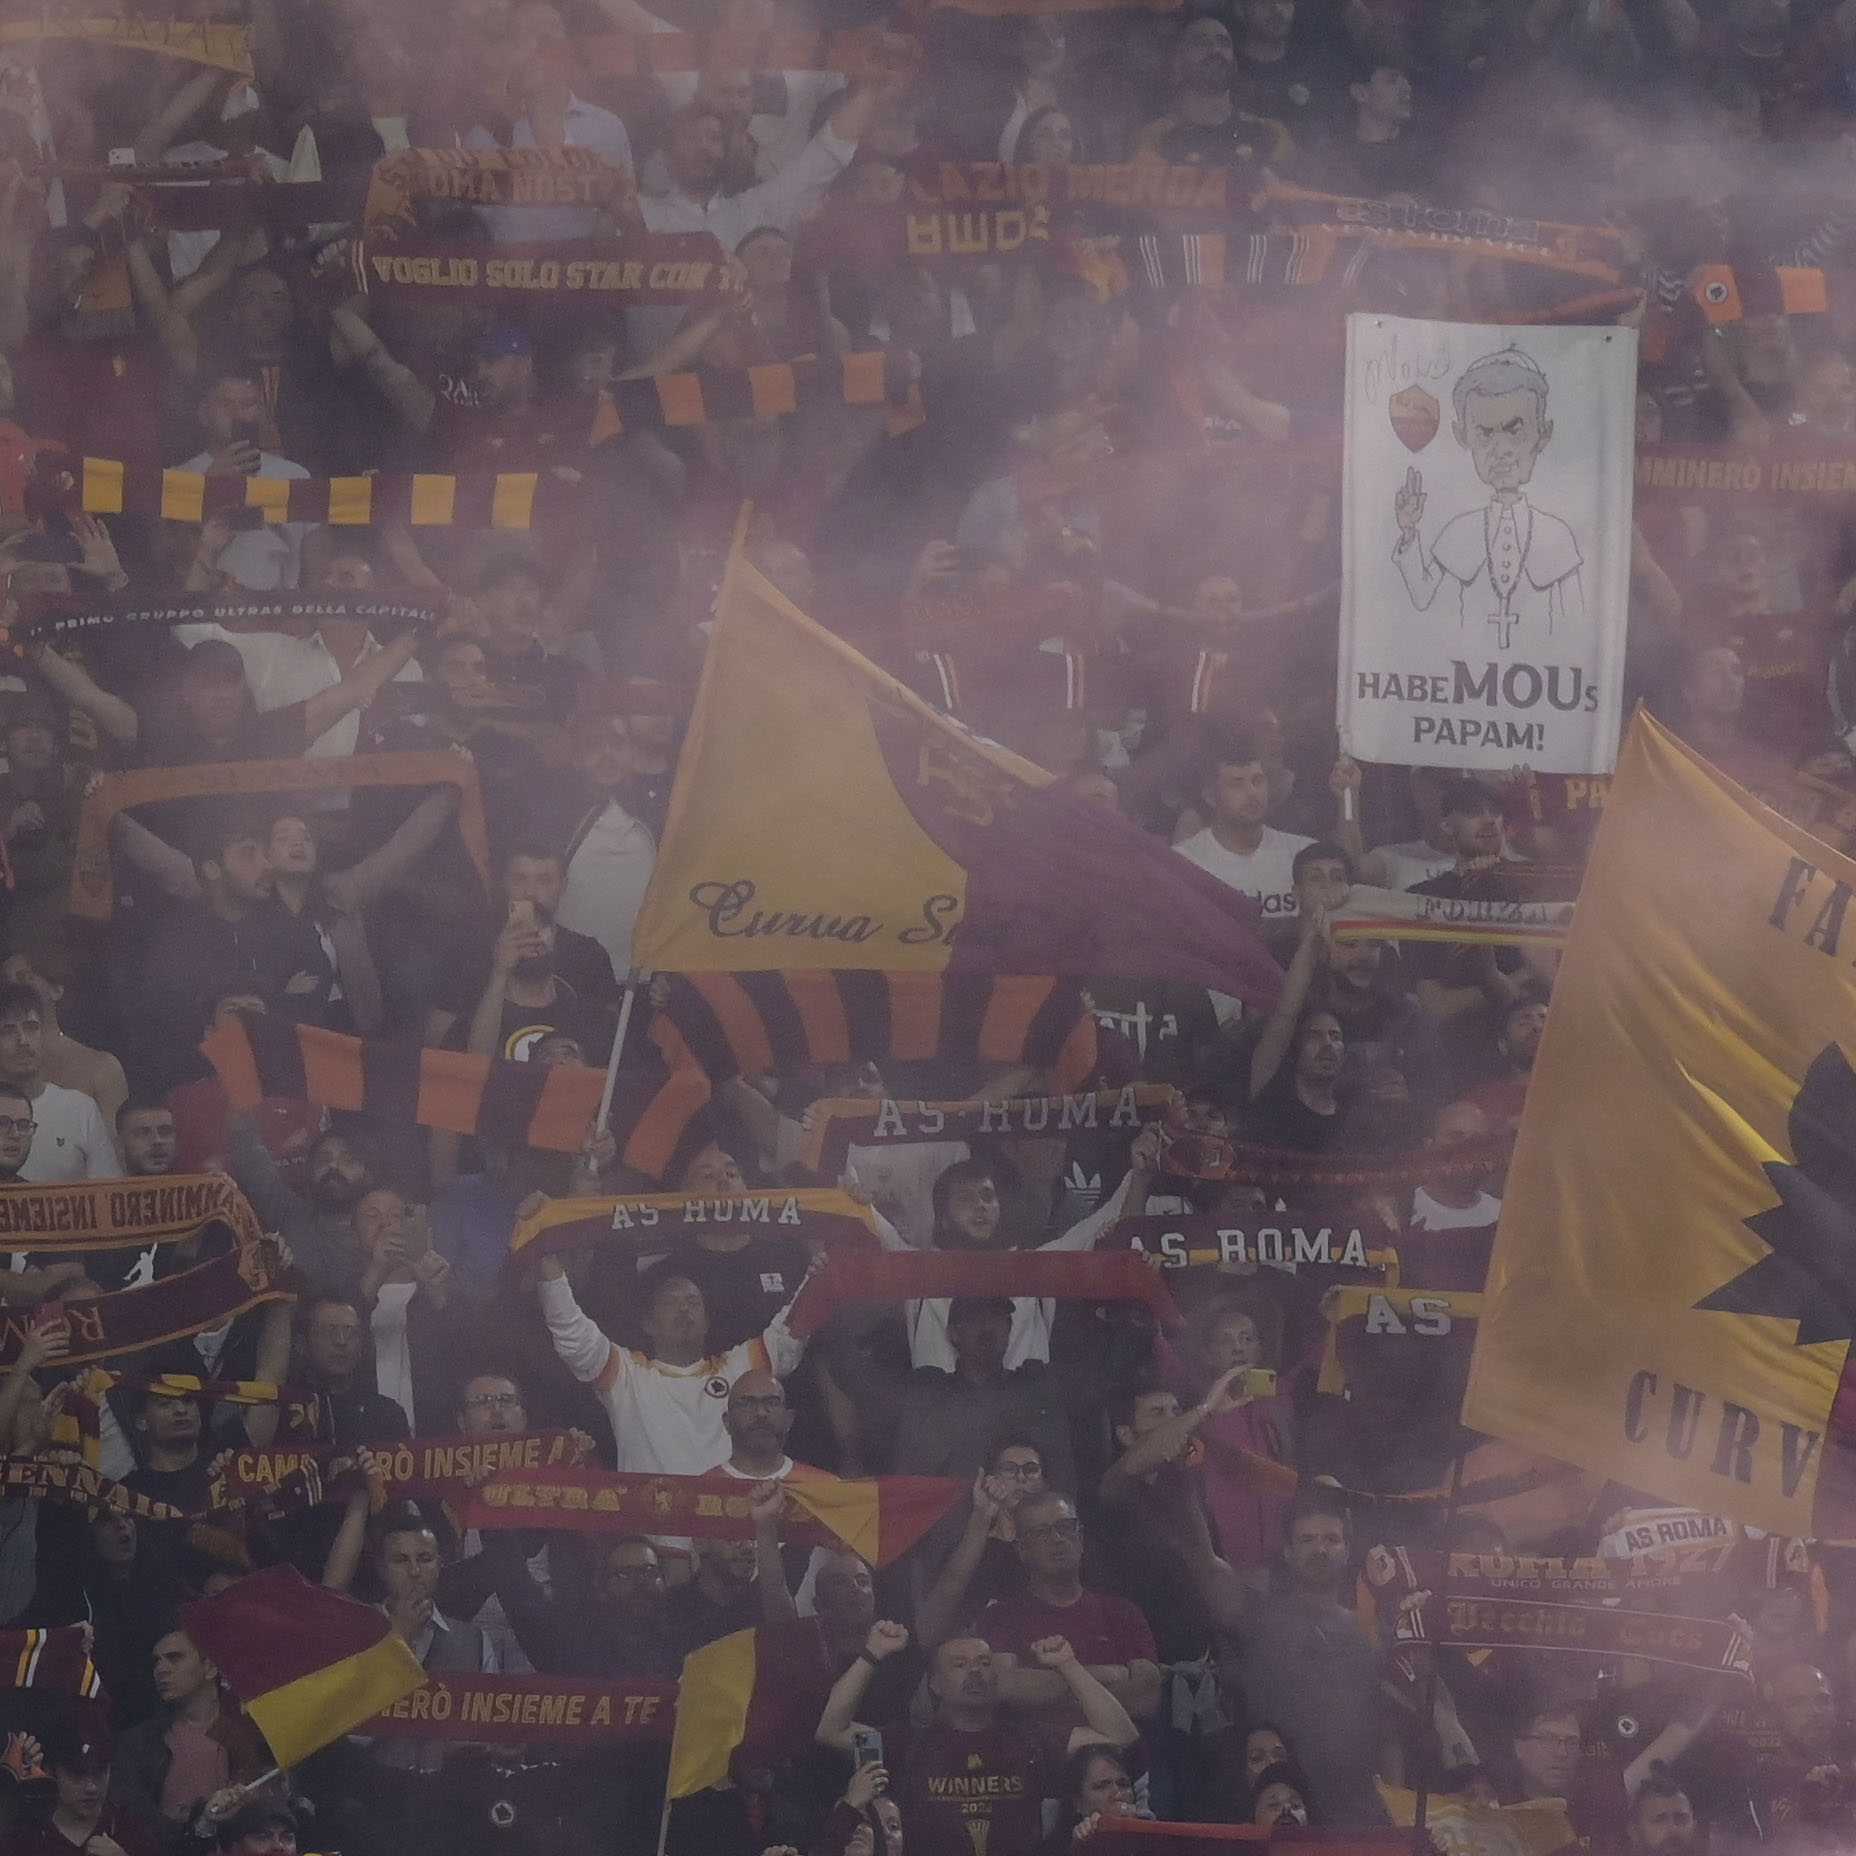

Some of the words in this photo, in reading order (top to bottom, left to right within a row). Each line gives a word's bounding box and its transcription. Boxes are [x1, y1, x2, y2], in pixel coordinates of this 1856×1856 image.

[372, 256, 479, 286] VOGLIO
[485, 258, 560, 290] SOLO
[567, 261, 645, 291] STAR
[650, 262, 713, 290] CON
[1412, 721, 1546, 752] PAPAM!
[689, 880, 884, 944] Curva
[873, 1099, 945, 1137] AS
[977, 1081, 1145, 1135] ROMA
[612, 1200, 663, 1230] AS
[683, 1197, 802, 1227] ROMA
[1216, 1228, 1369, 1268] ROMA
[1365, 1295, 1453, 1336] AS
[1624, 1369, 1821, 1499] CURV
[423, 1438, 542, 1481] INSIEME
[1659, 1516, 1729, 1546] ROMA
[460, 1691, 586, 1725] INSIEME
[589, 1696, 613, 1725] A
[623, 1696, 661, 1723] TE
[927, 1775, 1025, 1796] WINNERS
